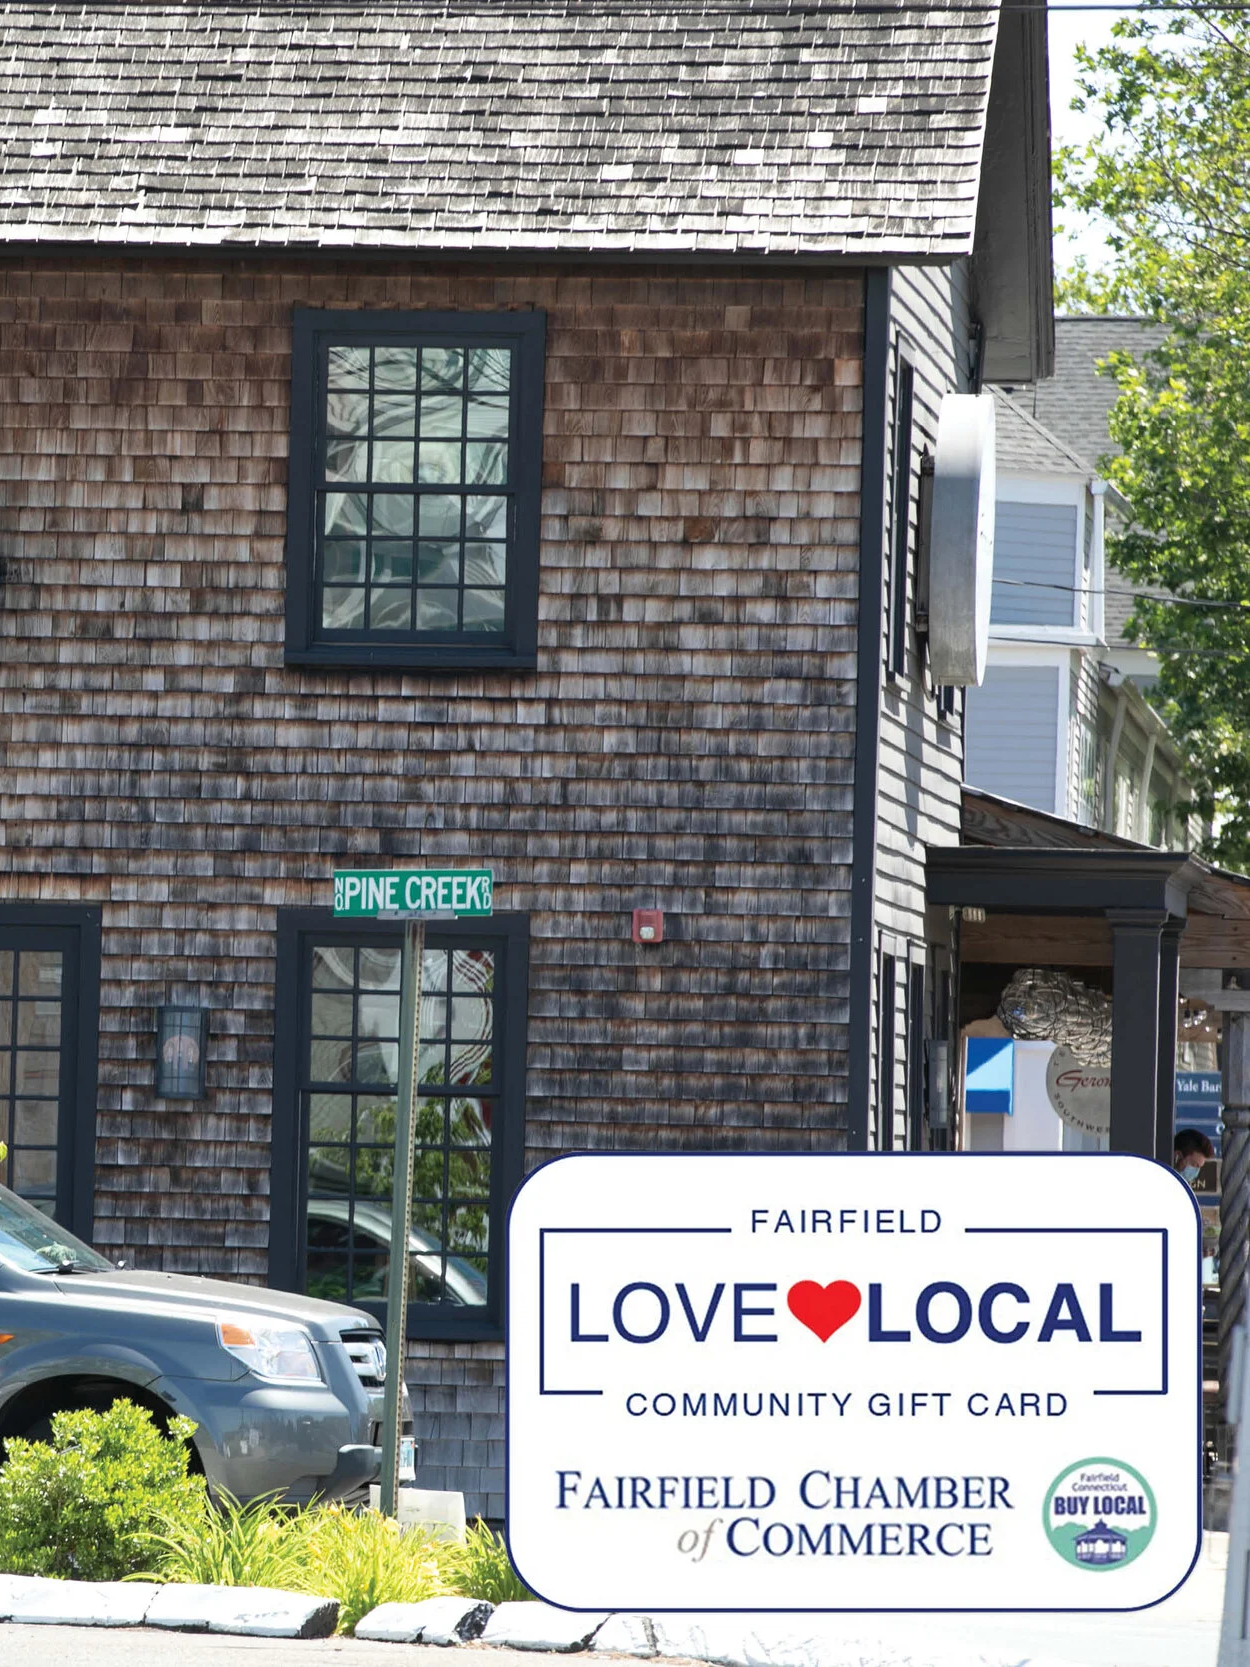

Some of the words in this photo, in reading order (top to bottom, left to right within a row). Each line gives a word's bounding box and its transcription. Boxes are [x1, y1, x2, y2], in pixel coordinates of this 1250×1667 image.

[345, 876, 400, 910] PINE
[405, 876, 482, 910] CREEK
[1056, 1069, 1111, 1093] Geron
[1176, 1078, 1199, 1092] Yale
[1054, 1092, 1110, 1133] SOUTHWE
